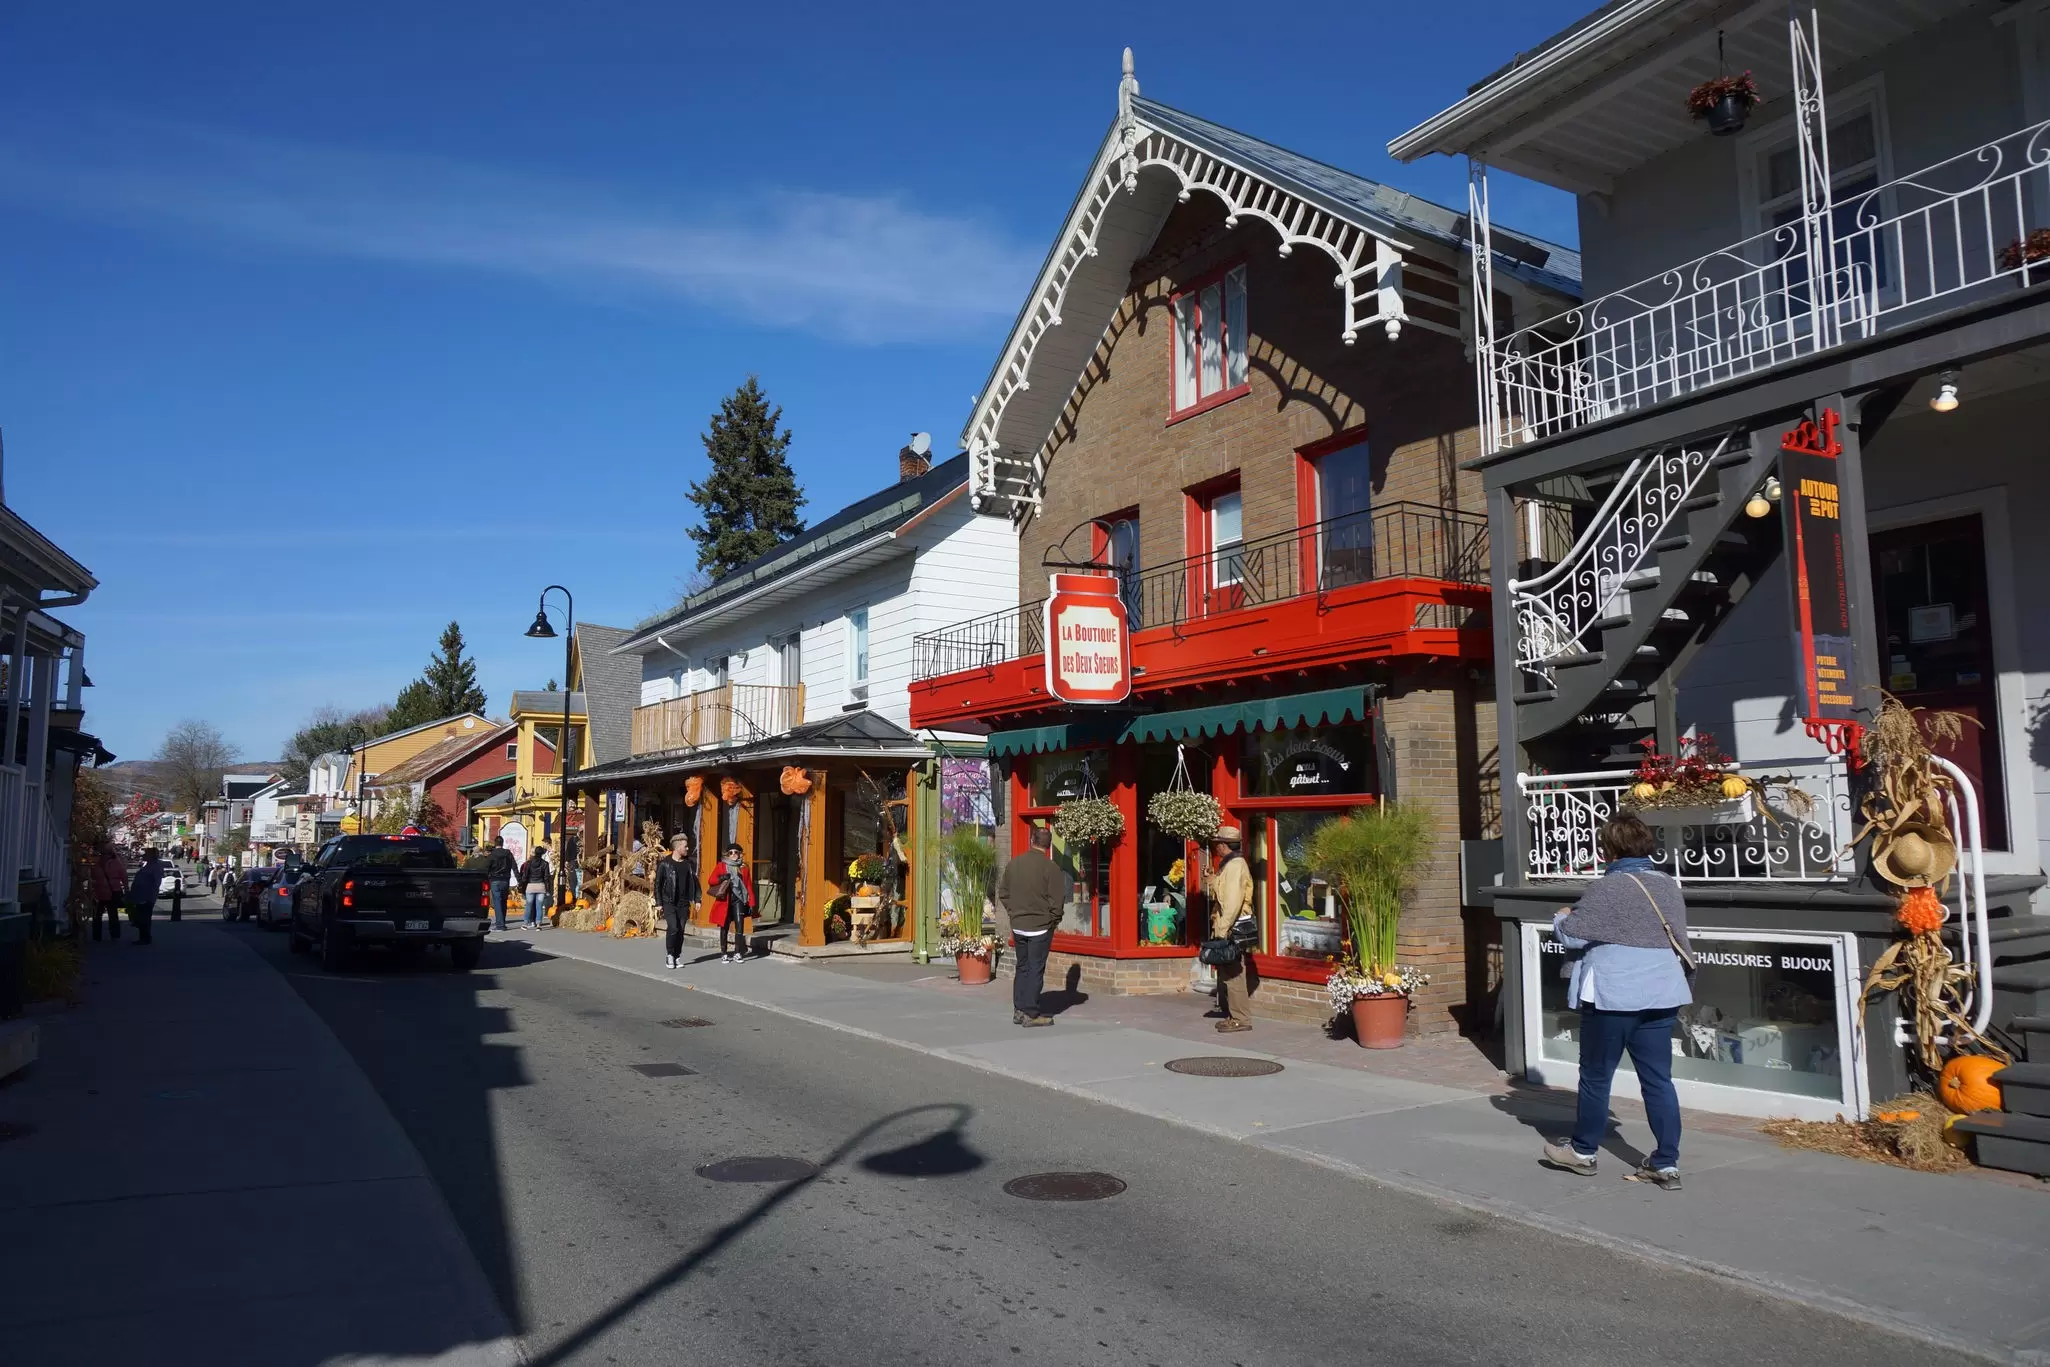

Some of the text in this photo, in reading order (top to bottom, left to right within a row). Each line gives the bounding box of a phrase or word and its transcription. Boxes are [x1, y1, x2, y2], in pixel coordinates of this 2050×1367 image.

[1800, 478, 1838, 501] AUTOUR
[1820, 500, 1839, 519] POT
[1062, 623, 1117, 643] LA BOUTIQUE
[1063, 652, 1119, 674] DES DEUX SOEURS
[1540, 940, 1565, 954] VÊTE
[1692, 951, 1773, 968] CHAUSSURES
[1781, 956, 1832, 972] BIJOUX
